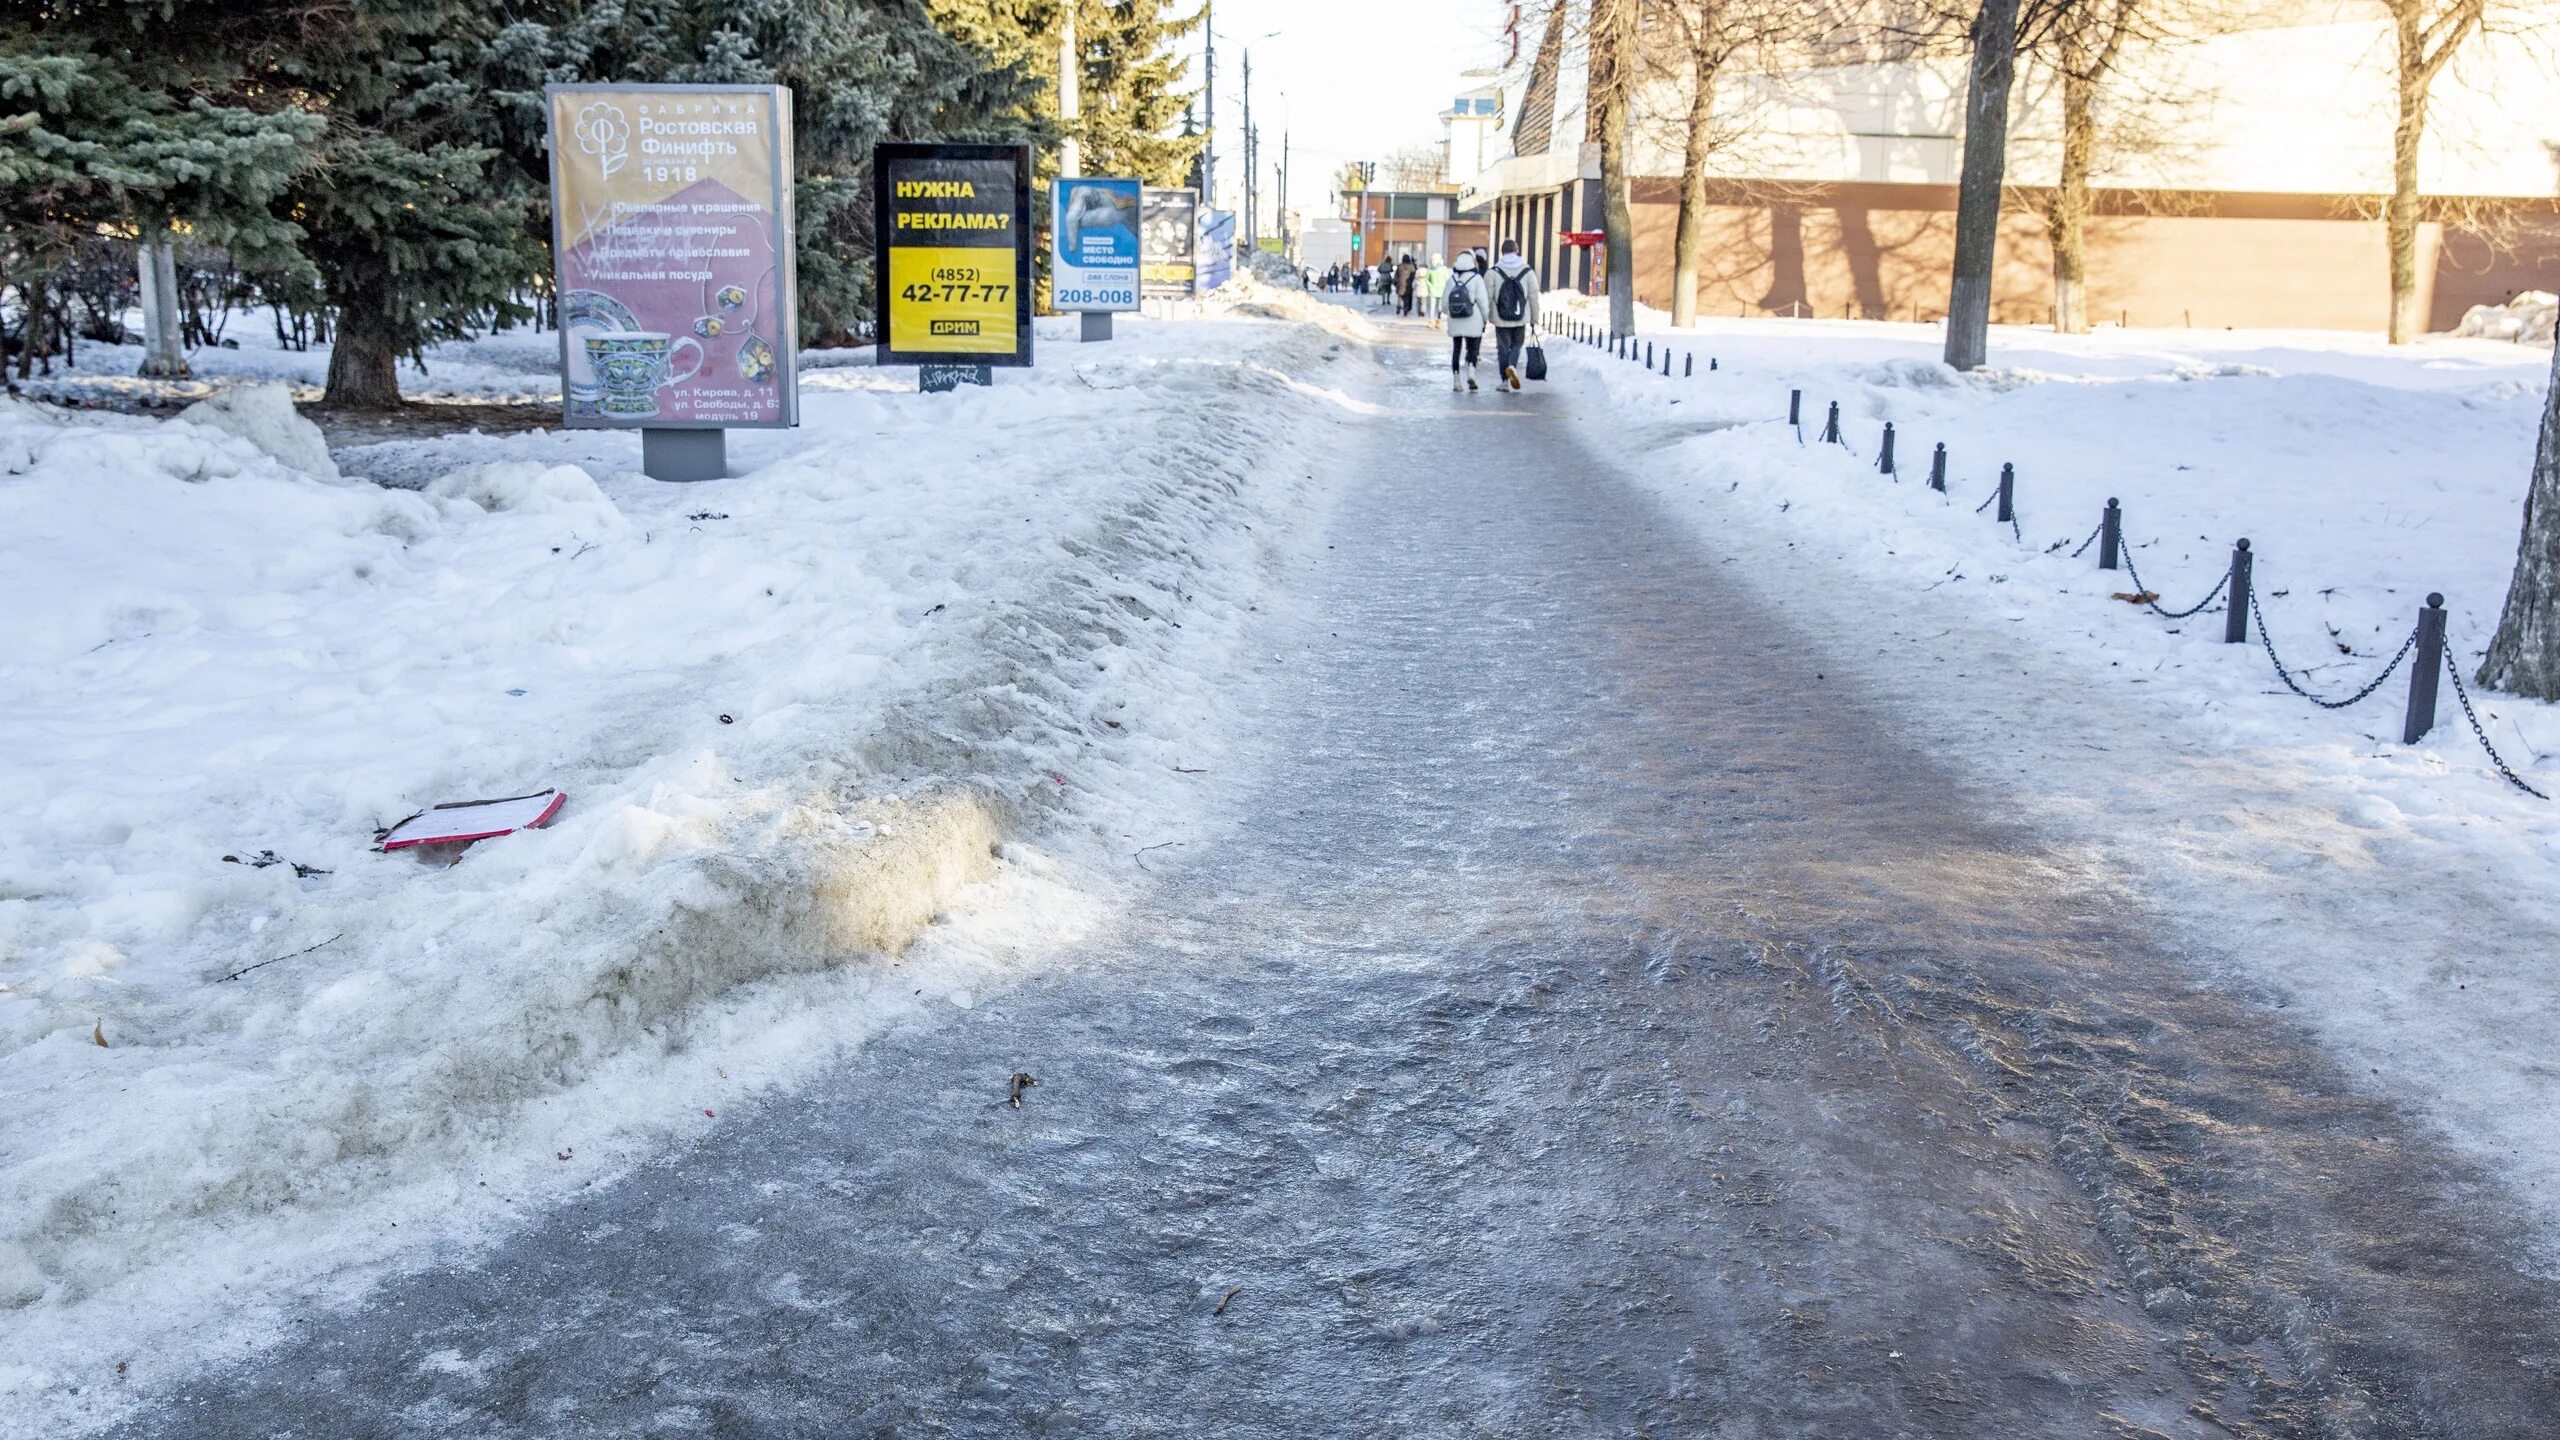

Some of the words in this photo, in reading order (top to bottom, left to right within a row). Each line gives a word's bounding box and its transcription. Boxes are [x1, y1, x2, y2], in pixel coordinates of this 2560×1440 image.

[639, 104, 755, 114] ФАБРИКА
[640, 117, 757, 135] Ростовская
[641, 137, 737, 164] Финифть
[643, 167, 697, 182] 1918
[897, 181, 975, 198] НУЖНА
[692, 203, 761, 215] украшения
[898, 213, 1010, 230] РЕКЛАМА?
[1083, 256, 1133, 265] СВОБОДНО
[591, 269, 665, 280] Уникальная
[669, 271, 713, 281] посуда
[931, 268, 980, 283] (4852)
[902, 284, 1010, 302] 42-77-77
[1059, 289, 1133, 304] 208-008
[932, 322, 978, 334] ДРИМ
[673, 389, 690, 399] ул.
[694, 388, 741, 398] Кирова,
[743, 389, 755, 398] д.
[758, 387, 773, 396] 11
[674, 401, 690, 410] ул.
[694, 399, 750, 409] Свободы,
[752, 401, 763, 409] д.
[695, 412, 738, 421] модуль
[743, 411, 758, 420] 19
